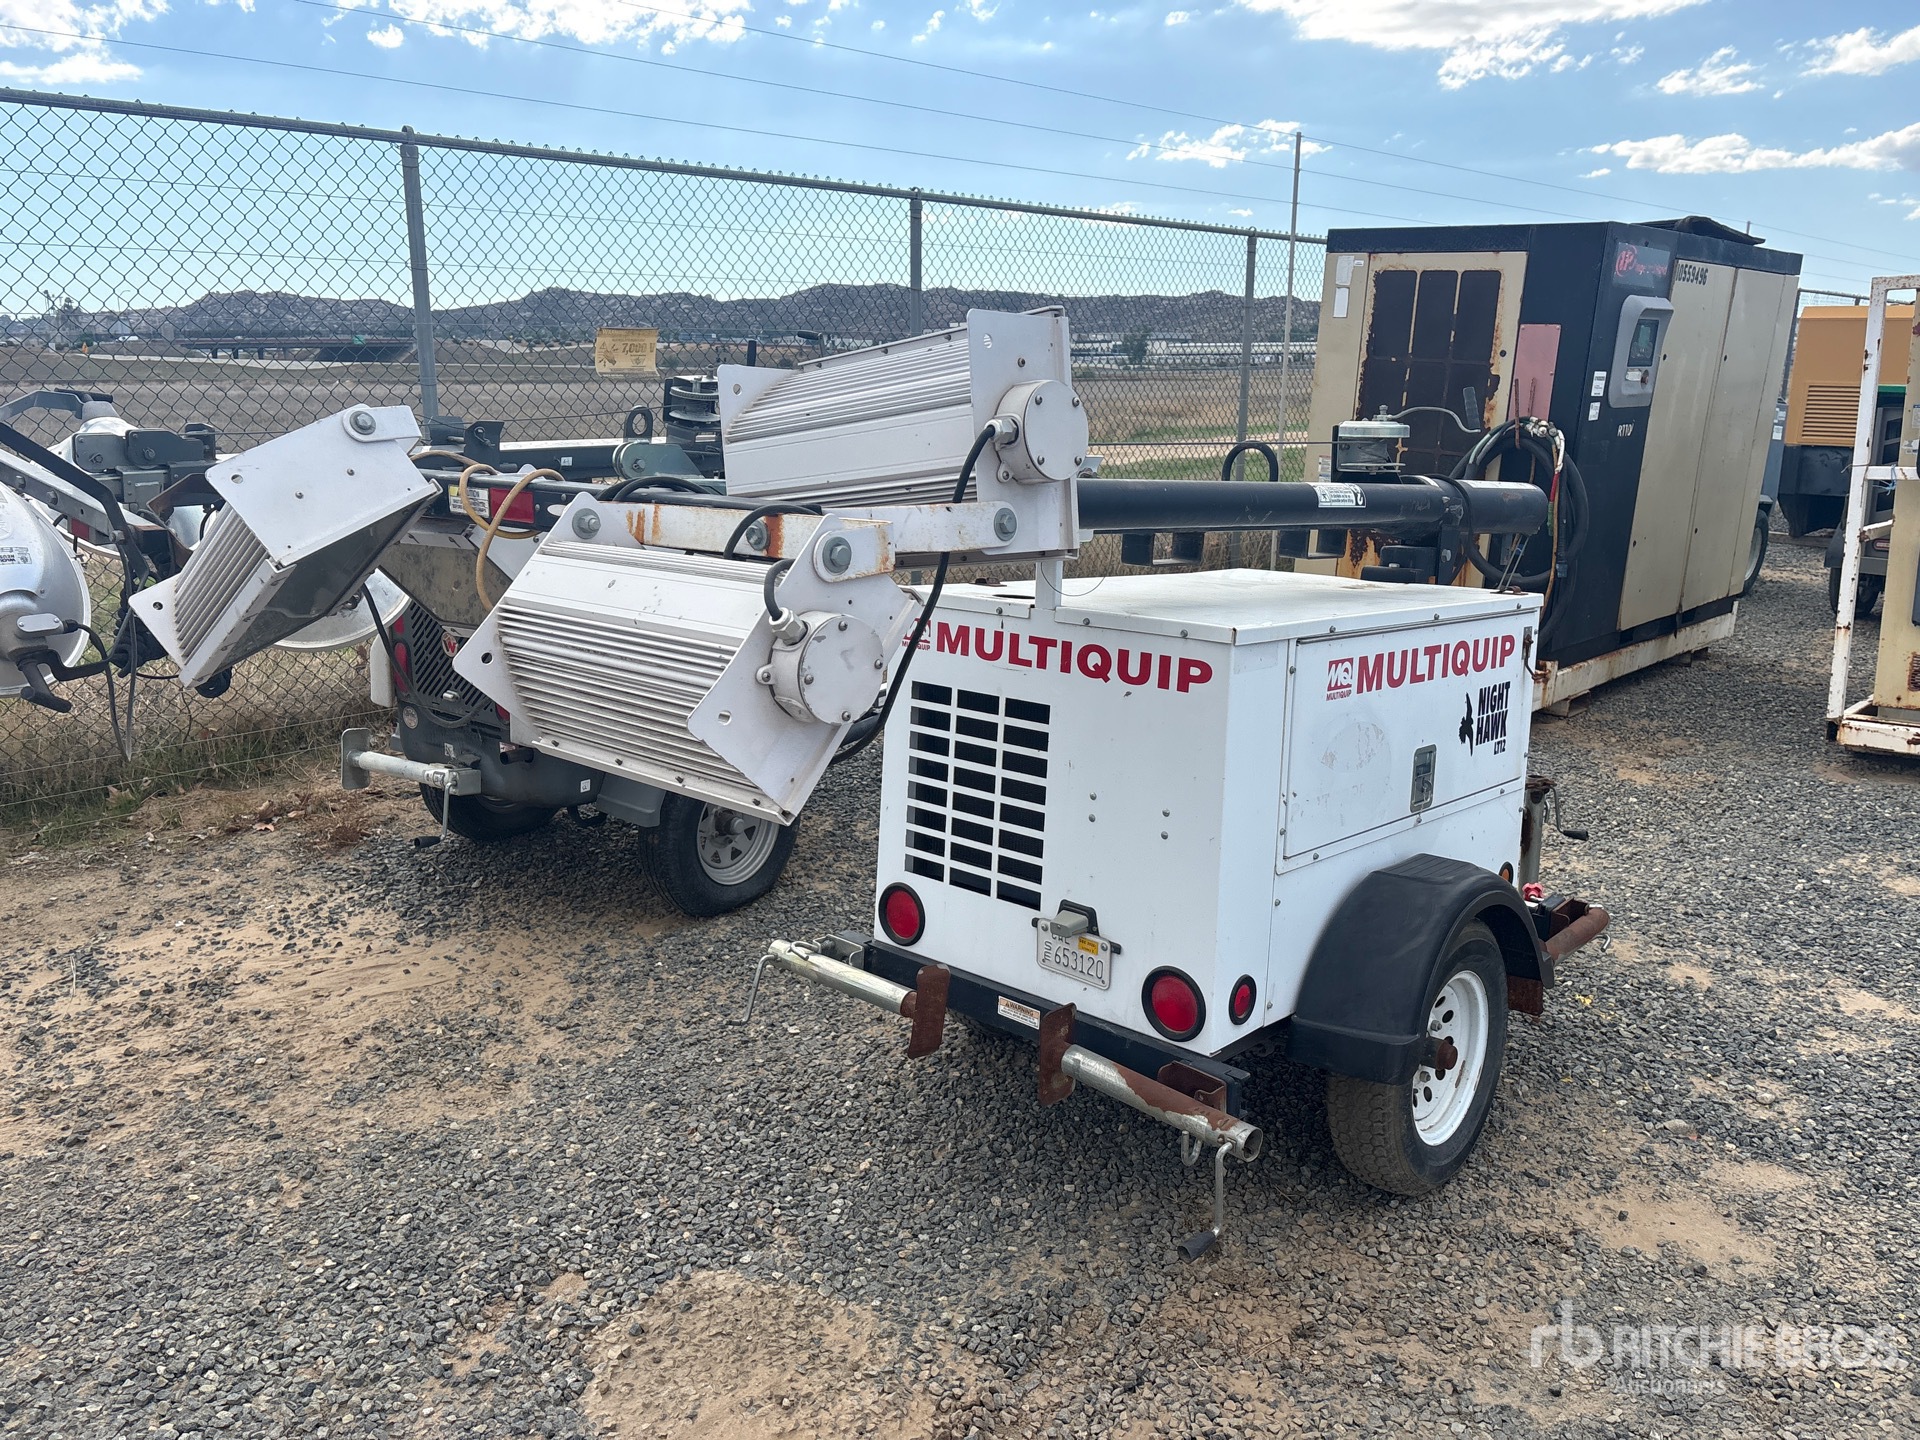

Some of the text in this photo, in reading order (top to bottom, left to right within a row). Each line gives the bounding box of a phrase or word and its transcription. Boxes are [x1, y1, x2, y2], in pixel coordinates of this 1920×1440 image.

[621, 342, 647, 355] 7,000
[936, 621, 1213, 693] MULTIQUIP
[1357, 635, 1515, 694] MULTIQUIP
[1326, 689, 1352, 701] MULTIQUIP
[1478, 681, 1511, 716] NIGHT
[1475, 710, 1509, 746] HAWK
[1493, 739, 1506, 755] LT12
[1054, 946, 1104, 980] 653120
